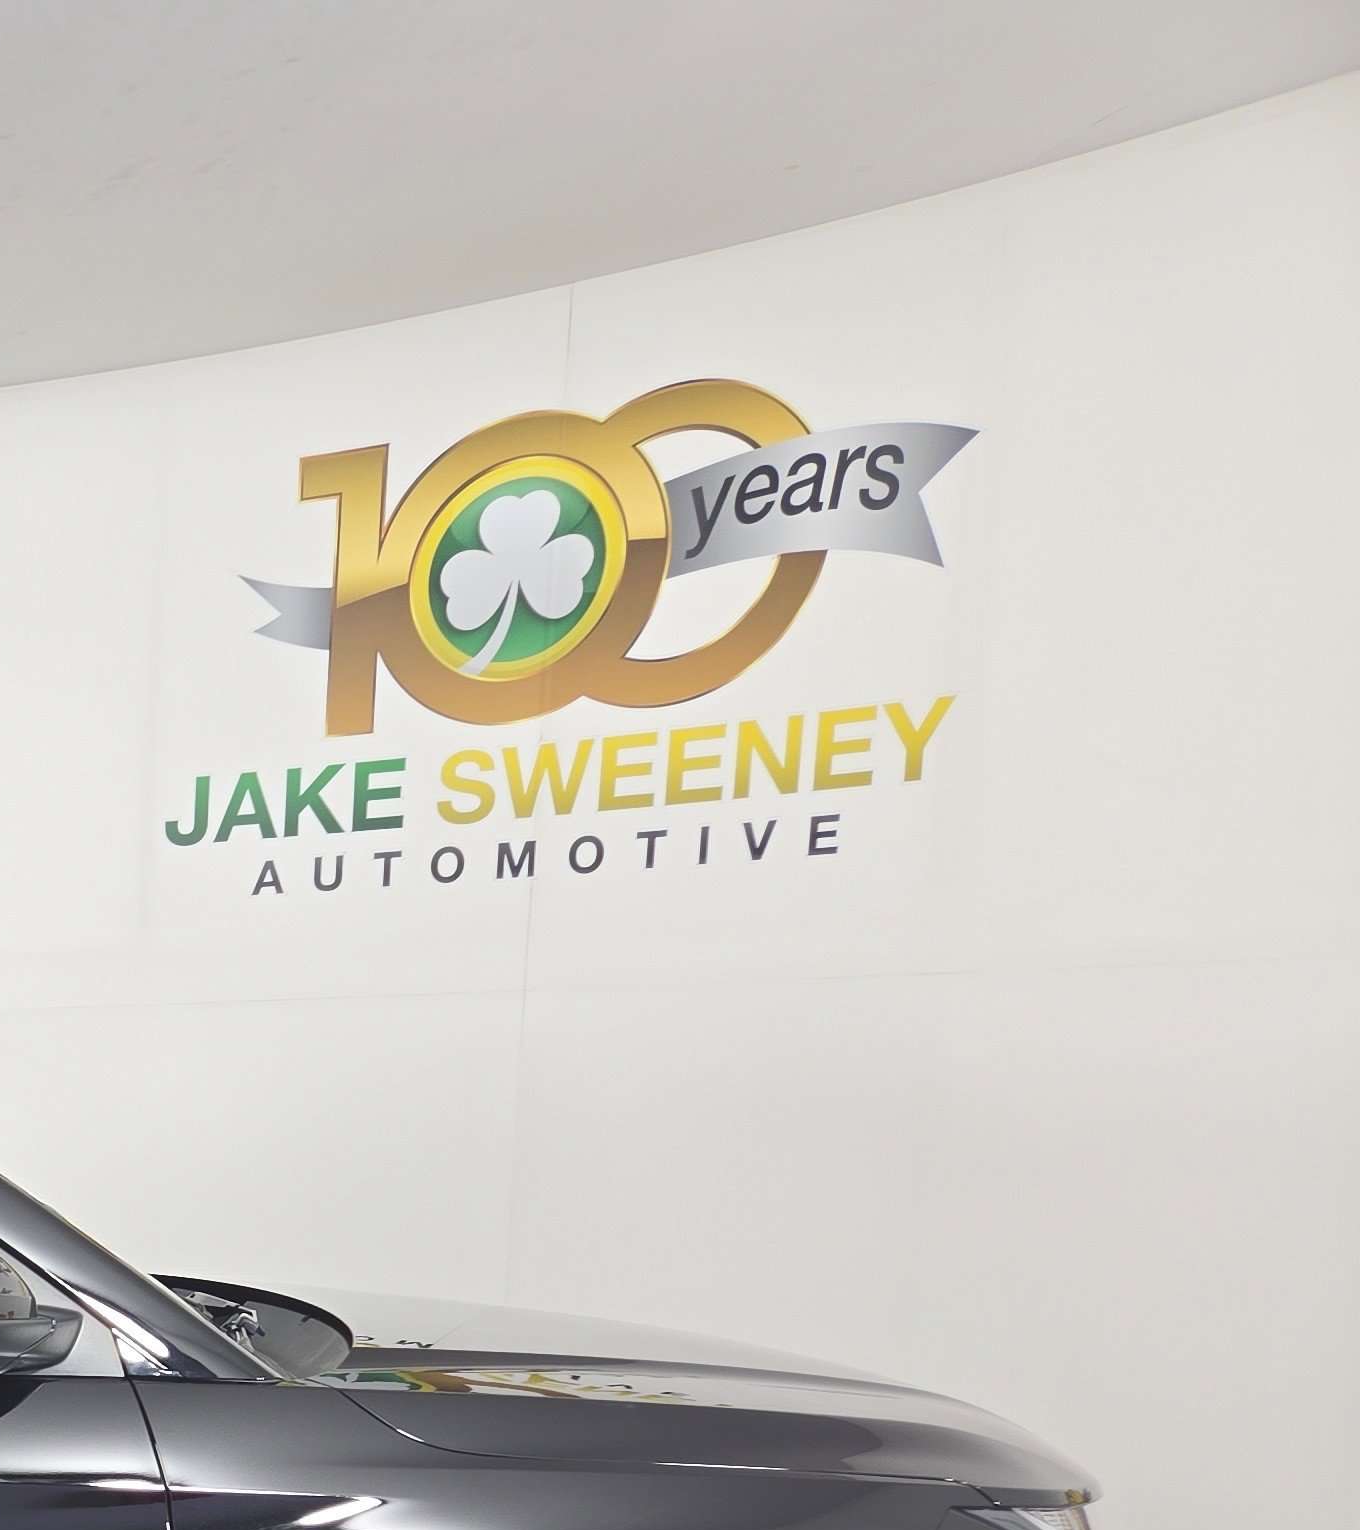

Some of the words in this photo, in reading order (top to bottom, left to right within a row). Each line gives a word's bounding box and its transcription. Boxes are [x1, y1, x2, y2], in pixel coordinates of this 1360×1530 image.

[299, 377, 830, 738] 100
[684, 443, 906, 561] years
[164, 757, 409, 847] JAKE
[436, 694, 958, 826] SWEENEY
[251, 813, 843, 897] AUTOMOTIVE
